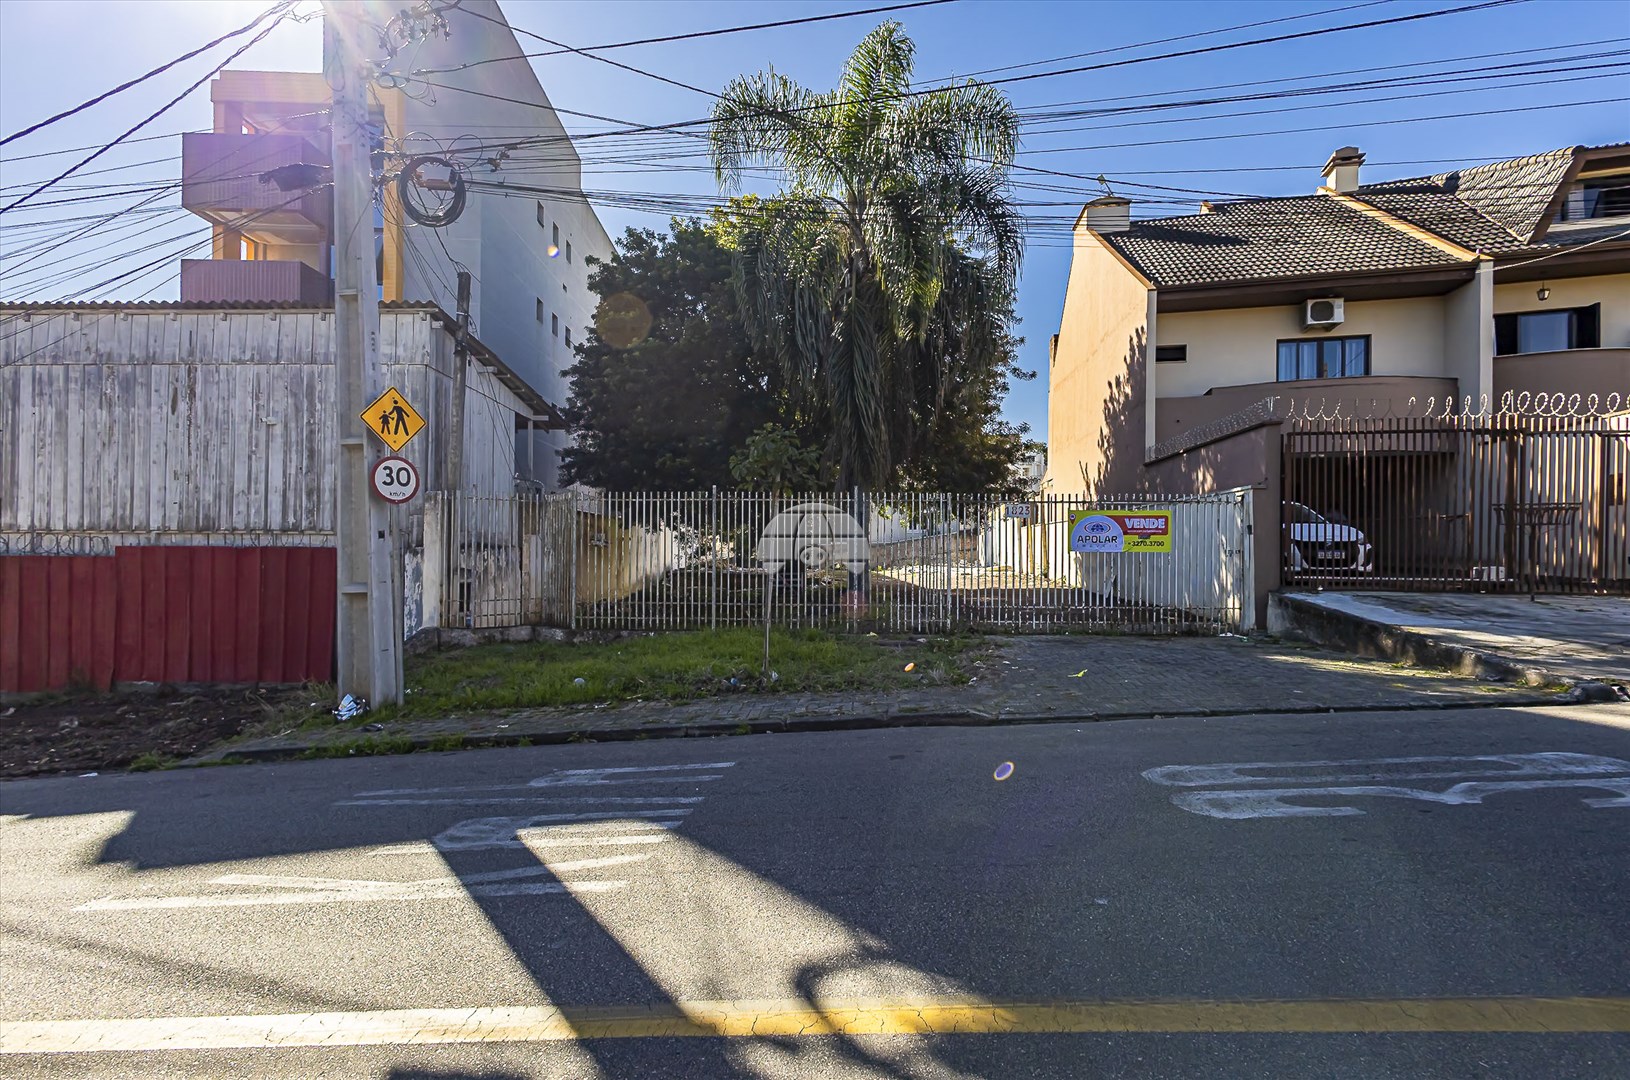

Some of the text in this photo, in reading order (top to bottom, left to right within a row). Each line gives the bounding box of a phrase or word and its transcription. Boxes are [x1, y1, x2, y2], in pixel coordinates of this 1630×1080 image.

[382, 466, 411, 487] 30
[1006, 505, 1030, 515] 1823
[1125, 518, 1165, 529] VENDE
[1077, 535, 1118, 544] APOLAR
